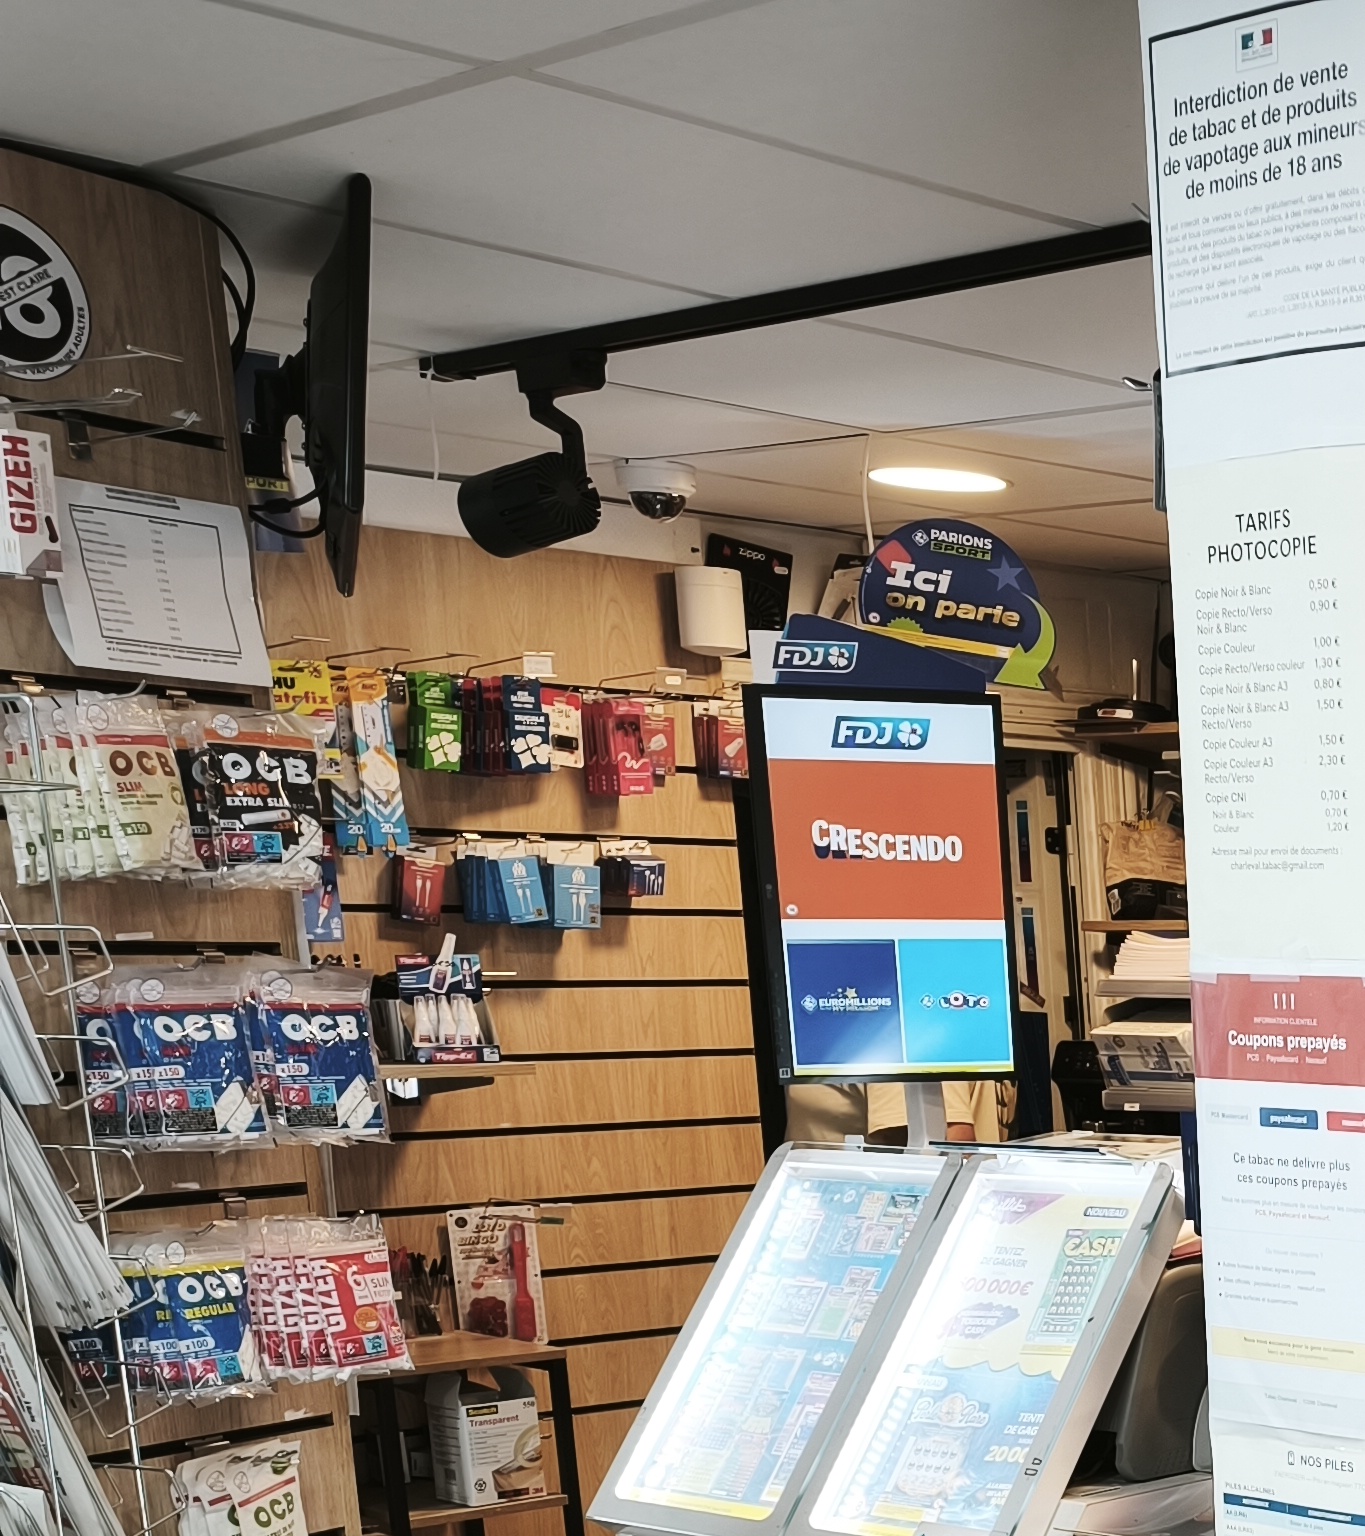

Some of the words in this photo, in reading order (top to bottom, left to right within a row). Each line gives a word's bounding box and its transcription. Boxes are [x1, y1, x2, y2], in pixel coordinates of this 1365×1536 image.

[1173, 79, 1268, 117] Interdiction
[1274, 73, 1294, 93] de
[1301, 61, 1348, 86] vente
[1169, 128, 1187, 147] de
[1193, 116, 1236, 142] tabac
[1241, 111, 1257, 131] et
[1262, 106, 1281, 125] de
[1286, 89, 1357, 125] produits
[1163, 157, 1181, 176] de
[1185, 135, 1258, 172] vapotage
[1264, 131, 1292, 152] aux
[1185, 180, 1204, 199] de
[1210, 167, 1257, 194] moins
[1263, 163, 1282, 182] de
[1287, 156, 1306, 176] 18
[1312, 151, 1342, 173] ans
[1, 435, 38, 534] GIZEH
[1235, 509, 1291, 533] TARIFS
[930, 529, 992, 550] PARIONS
[931, 541, 991, 560] SPORT
[1208, 535, 1317, 563] PHOTOCOPIE
[886, 560, 952, 595] Ici
[1195, 587, 1218, 602] Copie
[1221, 586, 1238, 598] Noir
[1240, 586, 1247, 596] &
[1249, 584, 1272, 596] Blanc
[1309, 578, 1328, 591] 0,50
[1331, 578, 1337, 589] €
[886, 592, 926, 611] on
[935, 597, 1020, 628] parie
[110, 749, 175, 777] OCB
[116, 781, 145, 793] SLIM
[223, 782, 271, 796] LONG
[812, 819, 963, 862] CRESCENDO
[819, 997, 892, 1008] EUROMILLIONS
[939, 991, 990, 1010] LOTO
[280, 1013, 359, 1041] OCB
[1228, 1030, 1284, 1049] Coupons
[1287, 1032, 1347, 1053] prepayés
[1233, 1152, 1245, 1164] Ce
[1248, 1153, 1275, 1167] tabac
[1277, 1158, 1289, 1168] ne
[1292, 1157, 1326, 1171] delivre
[1329, 1158, 1350, 1173] plus
[1237, 1174, 1253, 1183] ces
[1256, 1175, 1299, 1190] coupons
[1301, 1176, 1348, 1192] prepayés
[183, 1304, 236, 1320] REGULAR
[469, 1414, 519, 1427] Transparent
